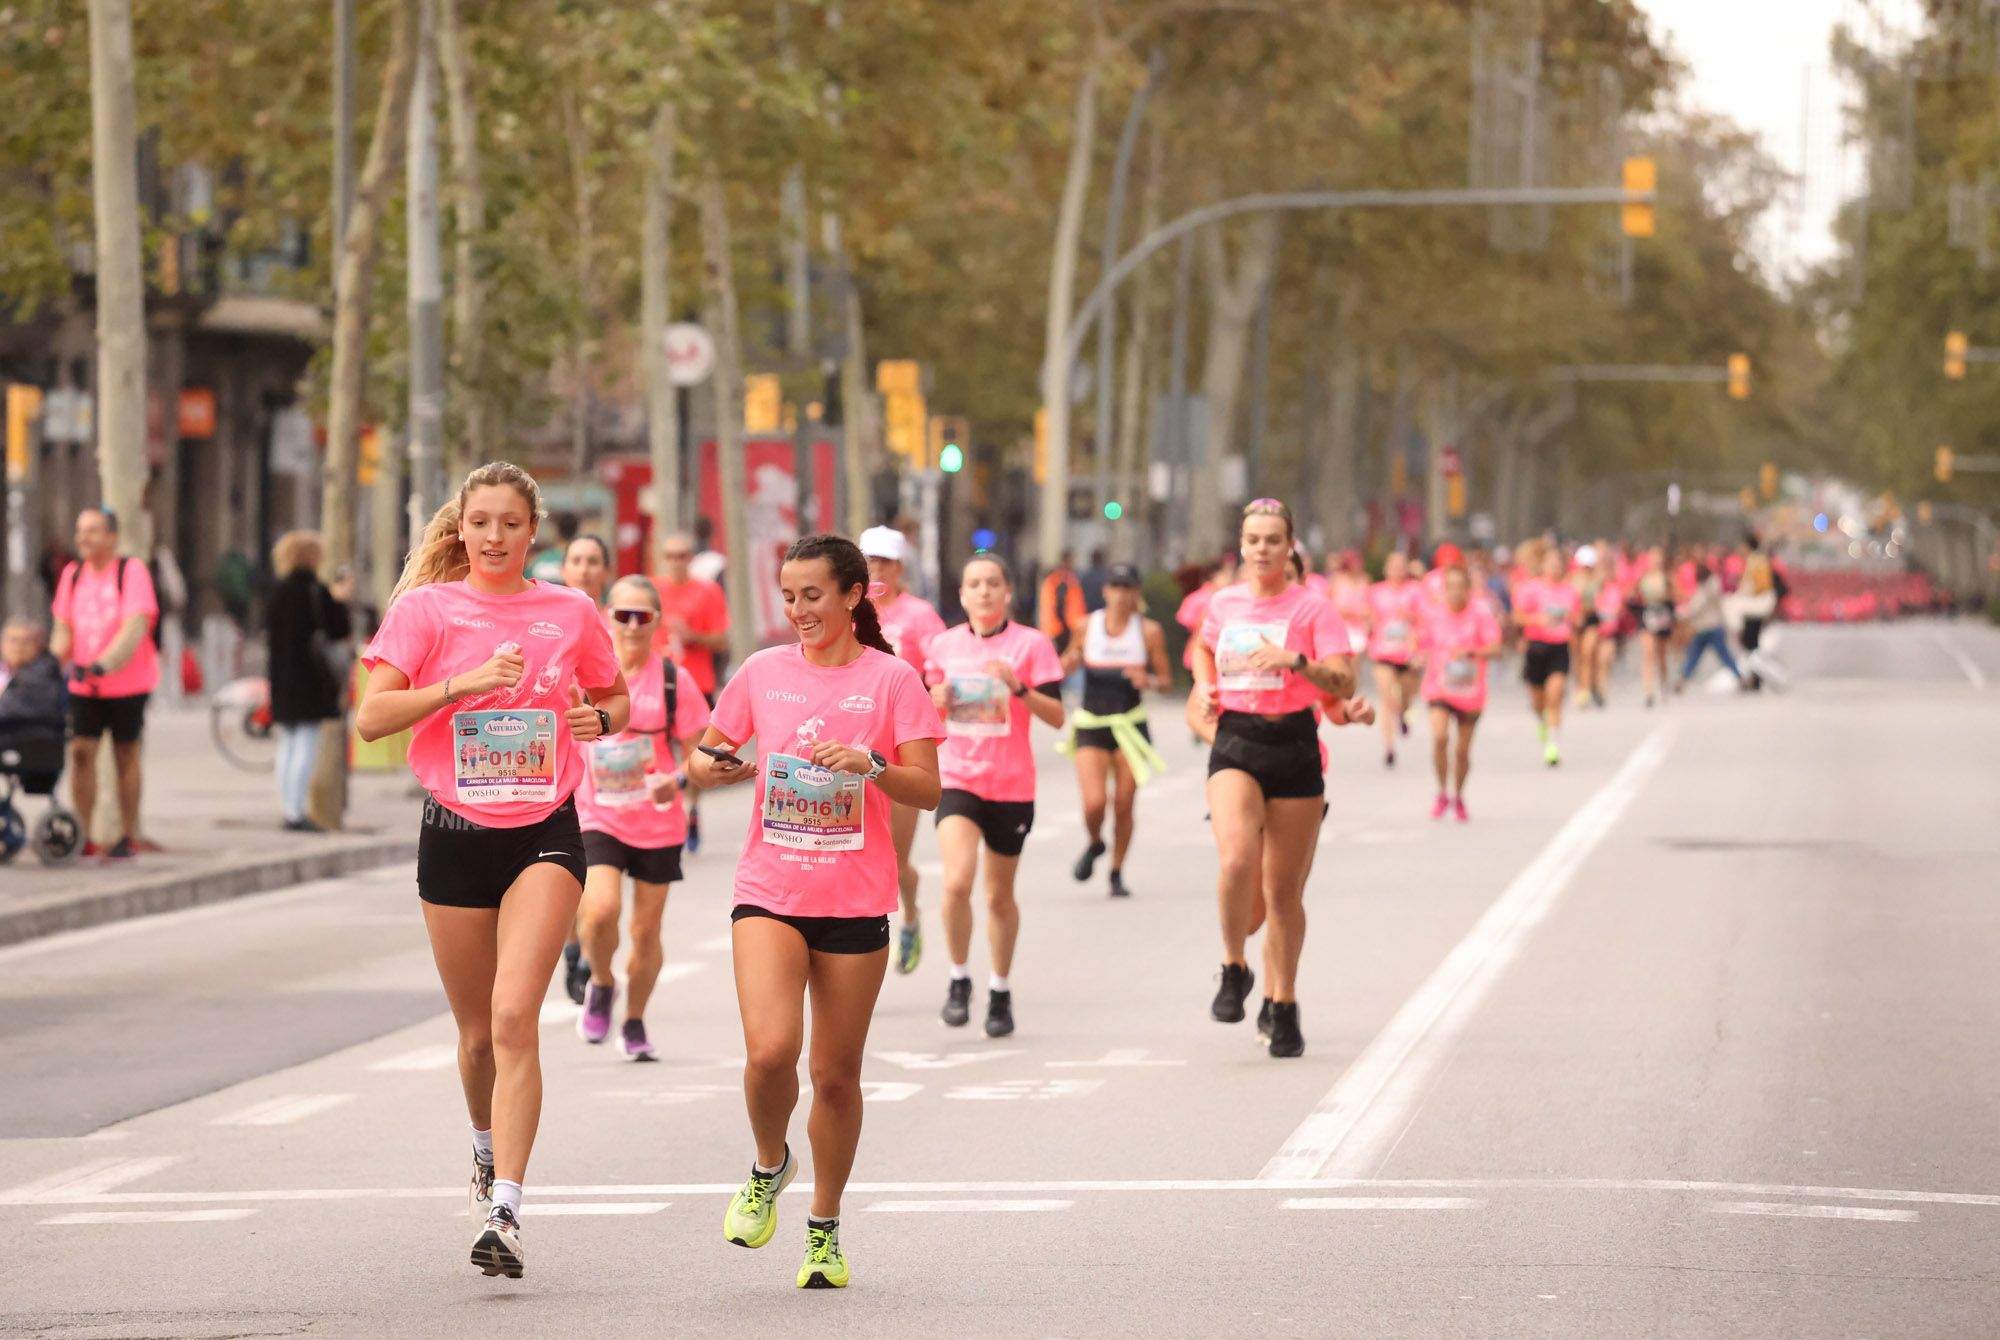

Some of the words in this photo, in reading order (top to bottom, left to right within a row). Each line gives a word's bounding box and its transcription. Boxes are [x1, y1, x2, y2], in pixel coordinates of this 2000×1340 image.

[766, 688, 808, 704] OYSHO
[486, 723, 526, 733] ASTURIANA
[489, 750, 527, 766] 016
[497, 769, 517, 777] 9518
[796, 770, 832, 783] ASTURIANA
[467, 789, 500, 798] OYSHO
[519, 788, 546, 796] Santander
[796, 798, 832, 816] 016
[771, 821, 792, 830] CARRERA
[802, 817, 822, 826] 9515
[773, 832, 803, 844] OYSHO
[780, 853, 802, 862] CARRERA
